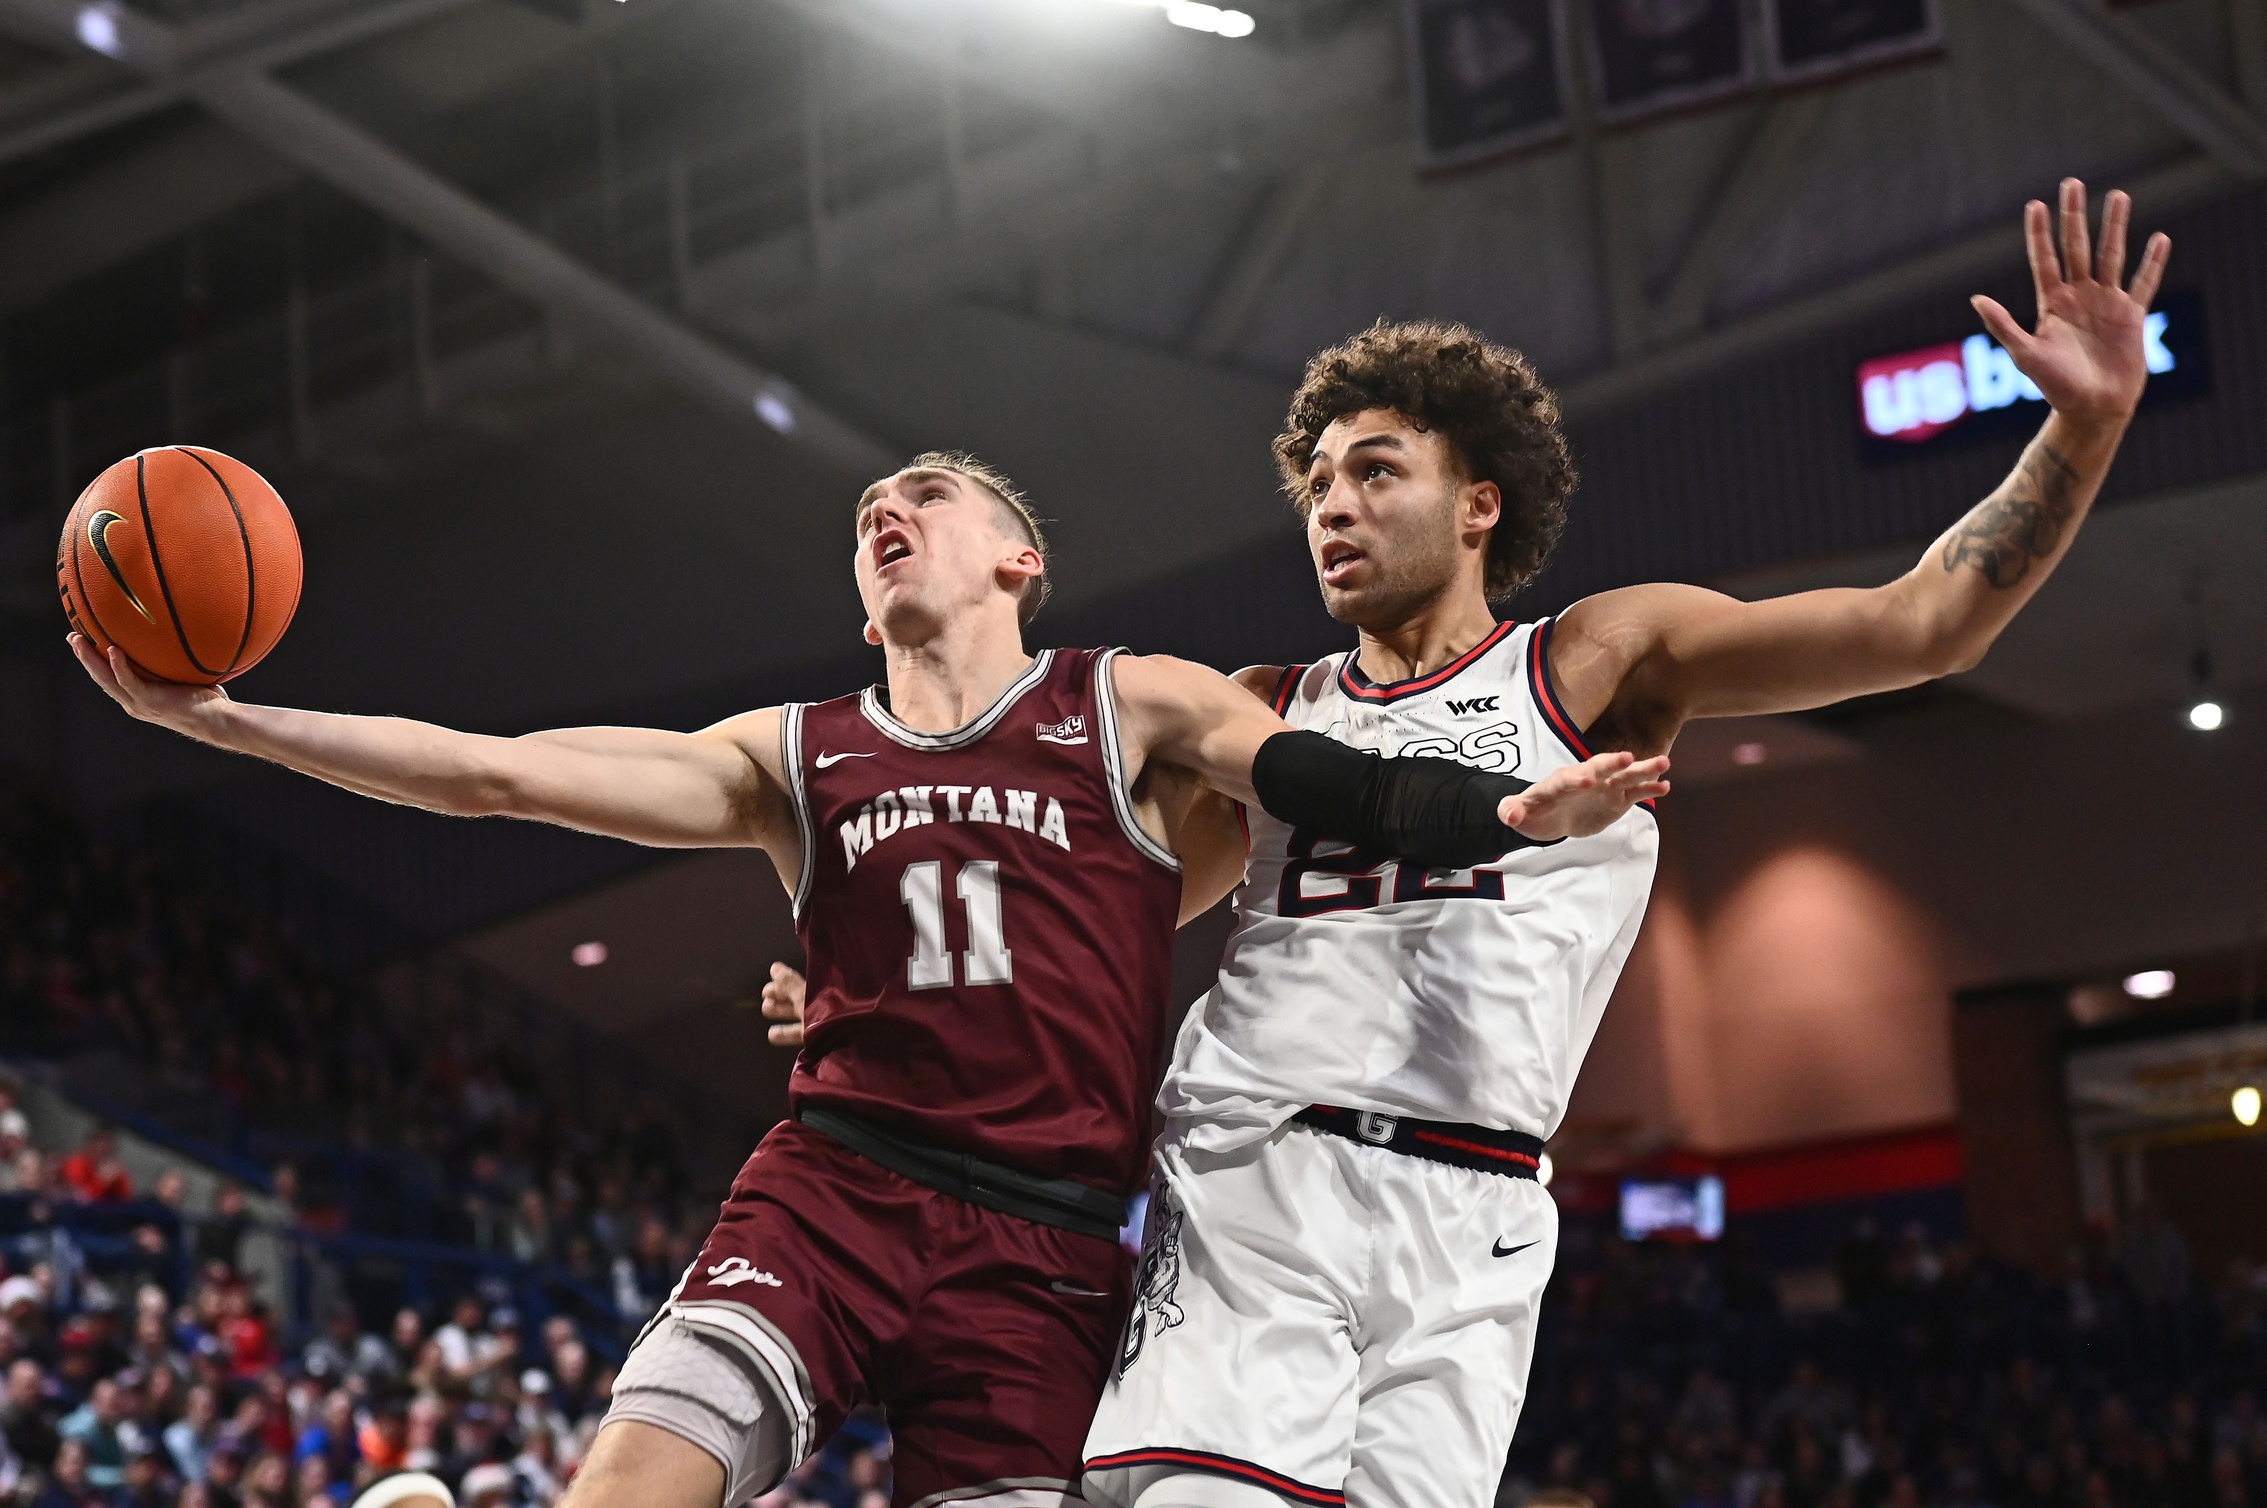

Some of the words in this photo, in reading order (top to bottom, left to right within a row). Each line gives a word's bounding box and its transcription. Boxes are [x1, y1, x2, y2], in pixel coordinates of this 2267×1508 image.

[1445, 695, 1500, 716] WCC
[839, 784, 1072, 875] MONTANA
[899, 860, 1013, 992] 11
[1357, 1111, 1399, 1145] G
